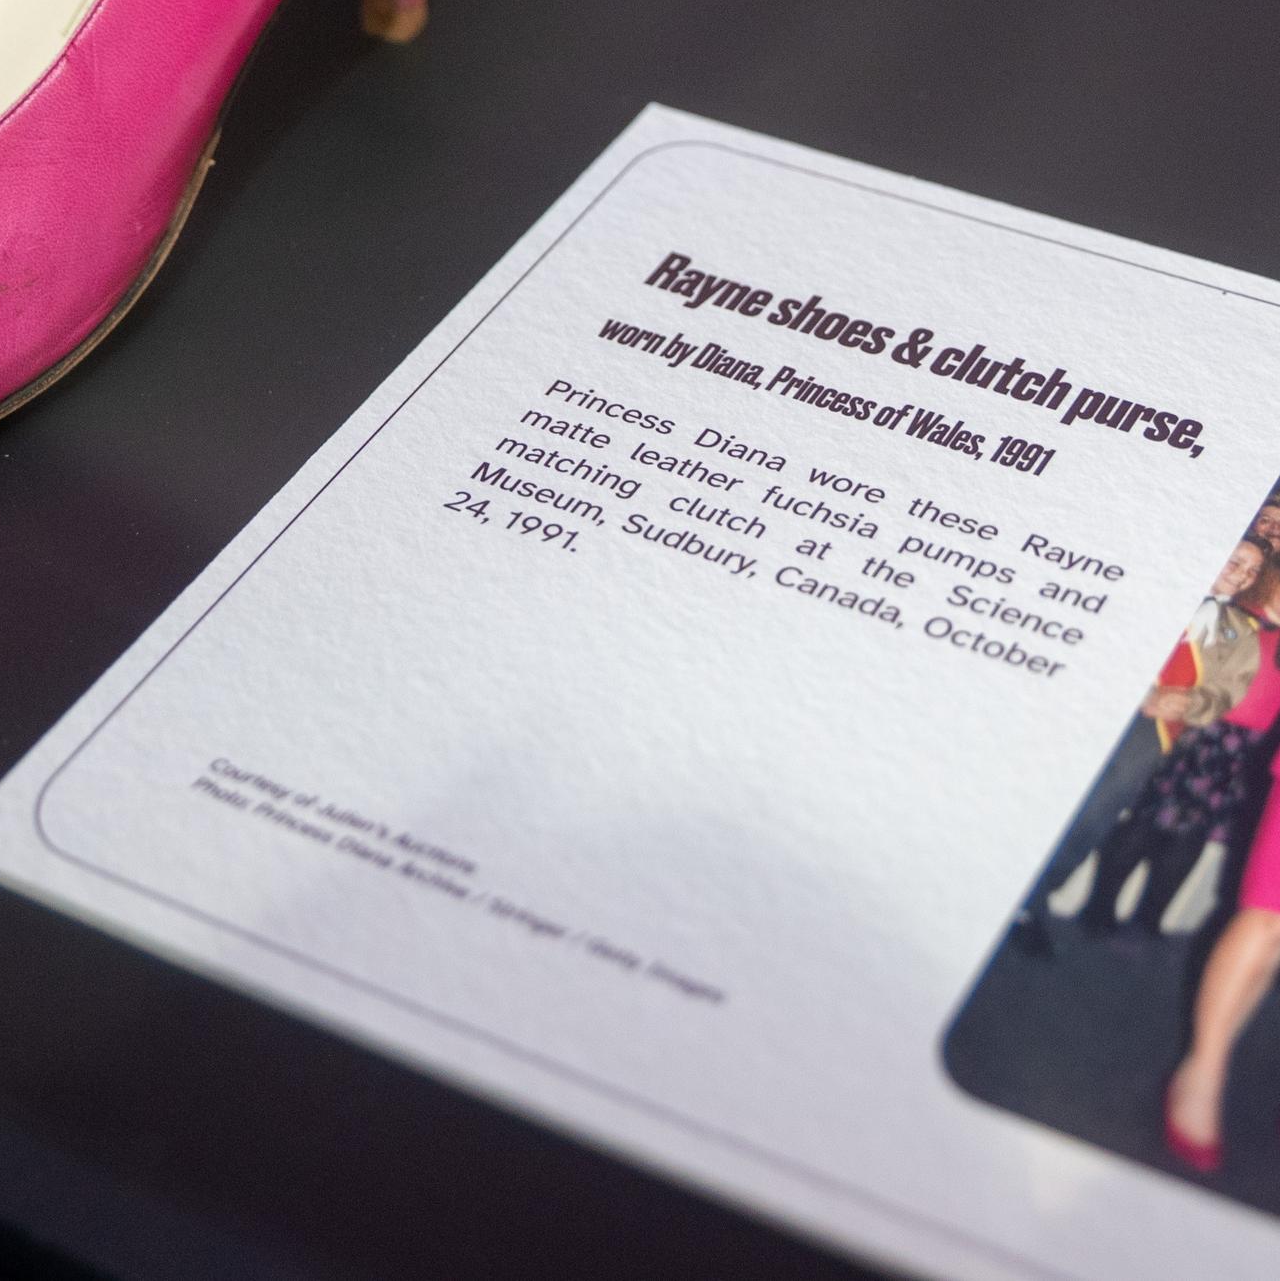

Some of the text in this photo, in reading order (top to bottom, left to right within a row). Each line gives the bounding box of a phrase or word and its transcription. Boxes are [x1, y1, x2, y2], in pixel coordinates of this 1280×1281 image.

[598, 318, 1056, 476] worn by Diana, Princess of Wales, 1991
[644, 251, 1205, 459] Rayne shoes & clutch purse,
[442, 491, 580, 552] 24, 1991.
[470, 462, 1067, 678] Museum, Sudbury, Canada, October
[495, 437, 1085, 646] matching clutch at the Science
[520, 409, 1109, 615] matte leather fuchsia pumps and
[544, 379, 1126, 582] Princess Diana wore these Rayne
[210, 758, 291, 800] Courtesy
